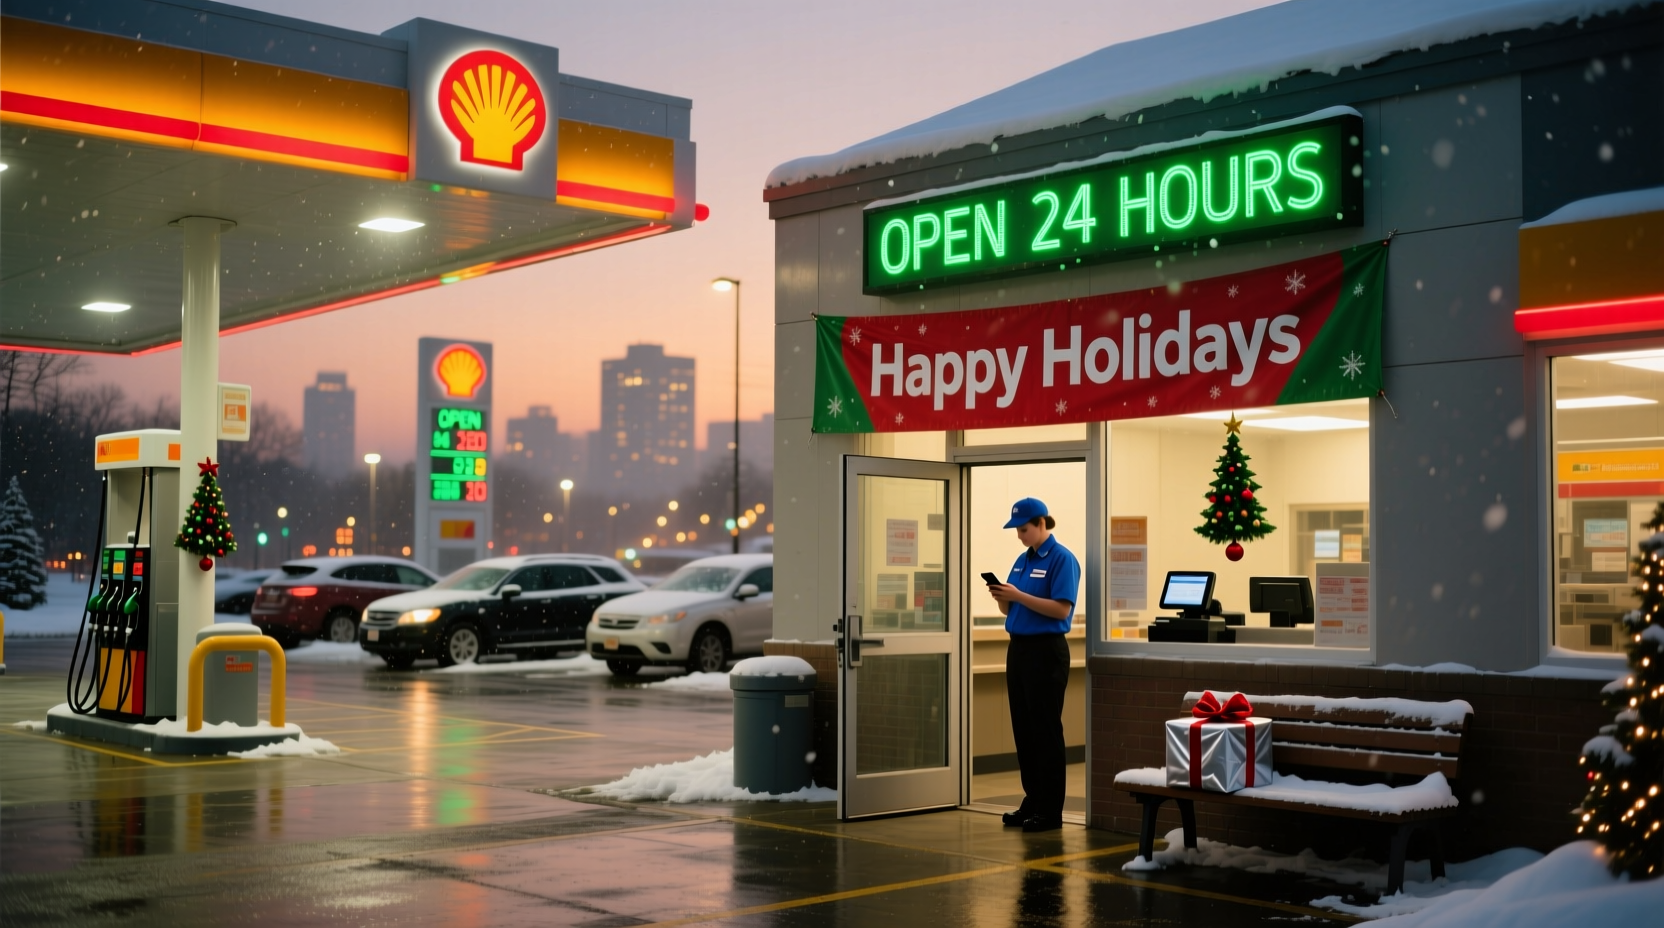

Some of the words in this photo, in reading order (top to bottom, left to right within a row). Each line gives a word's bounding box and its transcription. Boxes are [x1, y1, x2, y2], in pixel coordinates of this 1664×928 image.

[880, 200, 1006, 275] OPEN
[1031, 183, 1097, 252] 24
[1119, 141, 1324, 238] HOURS
[870, 342, 1029, 411] Happy
[1042, 308, 1301, 388] Holidays
[439, 409, 482, 430] OPEN
